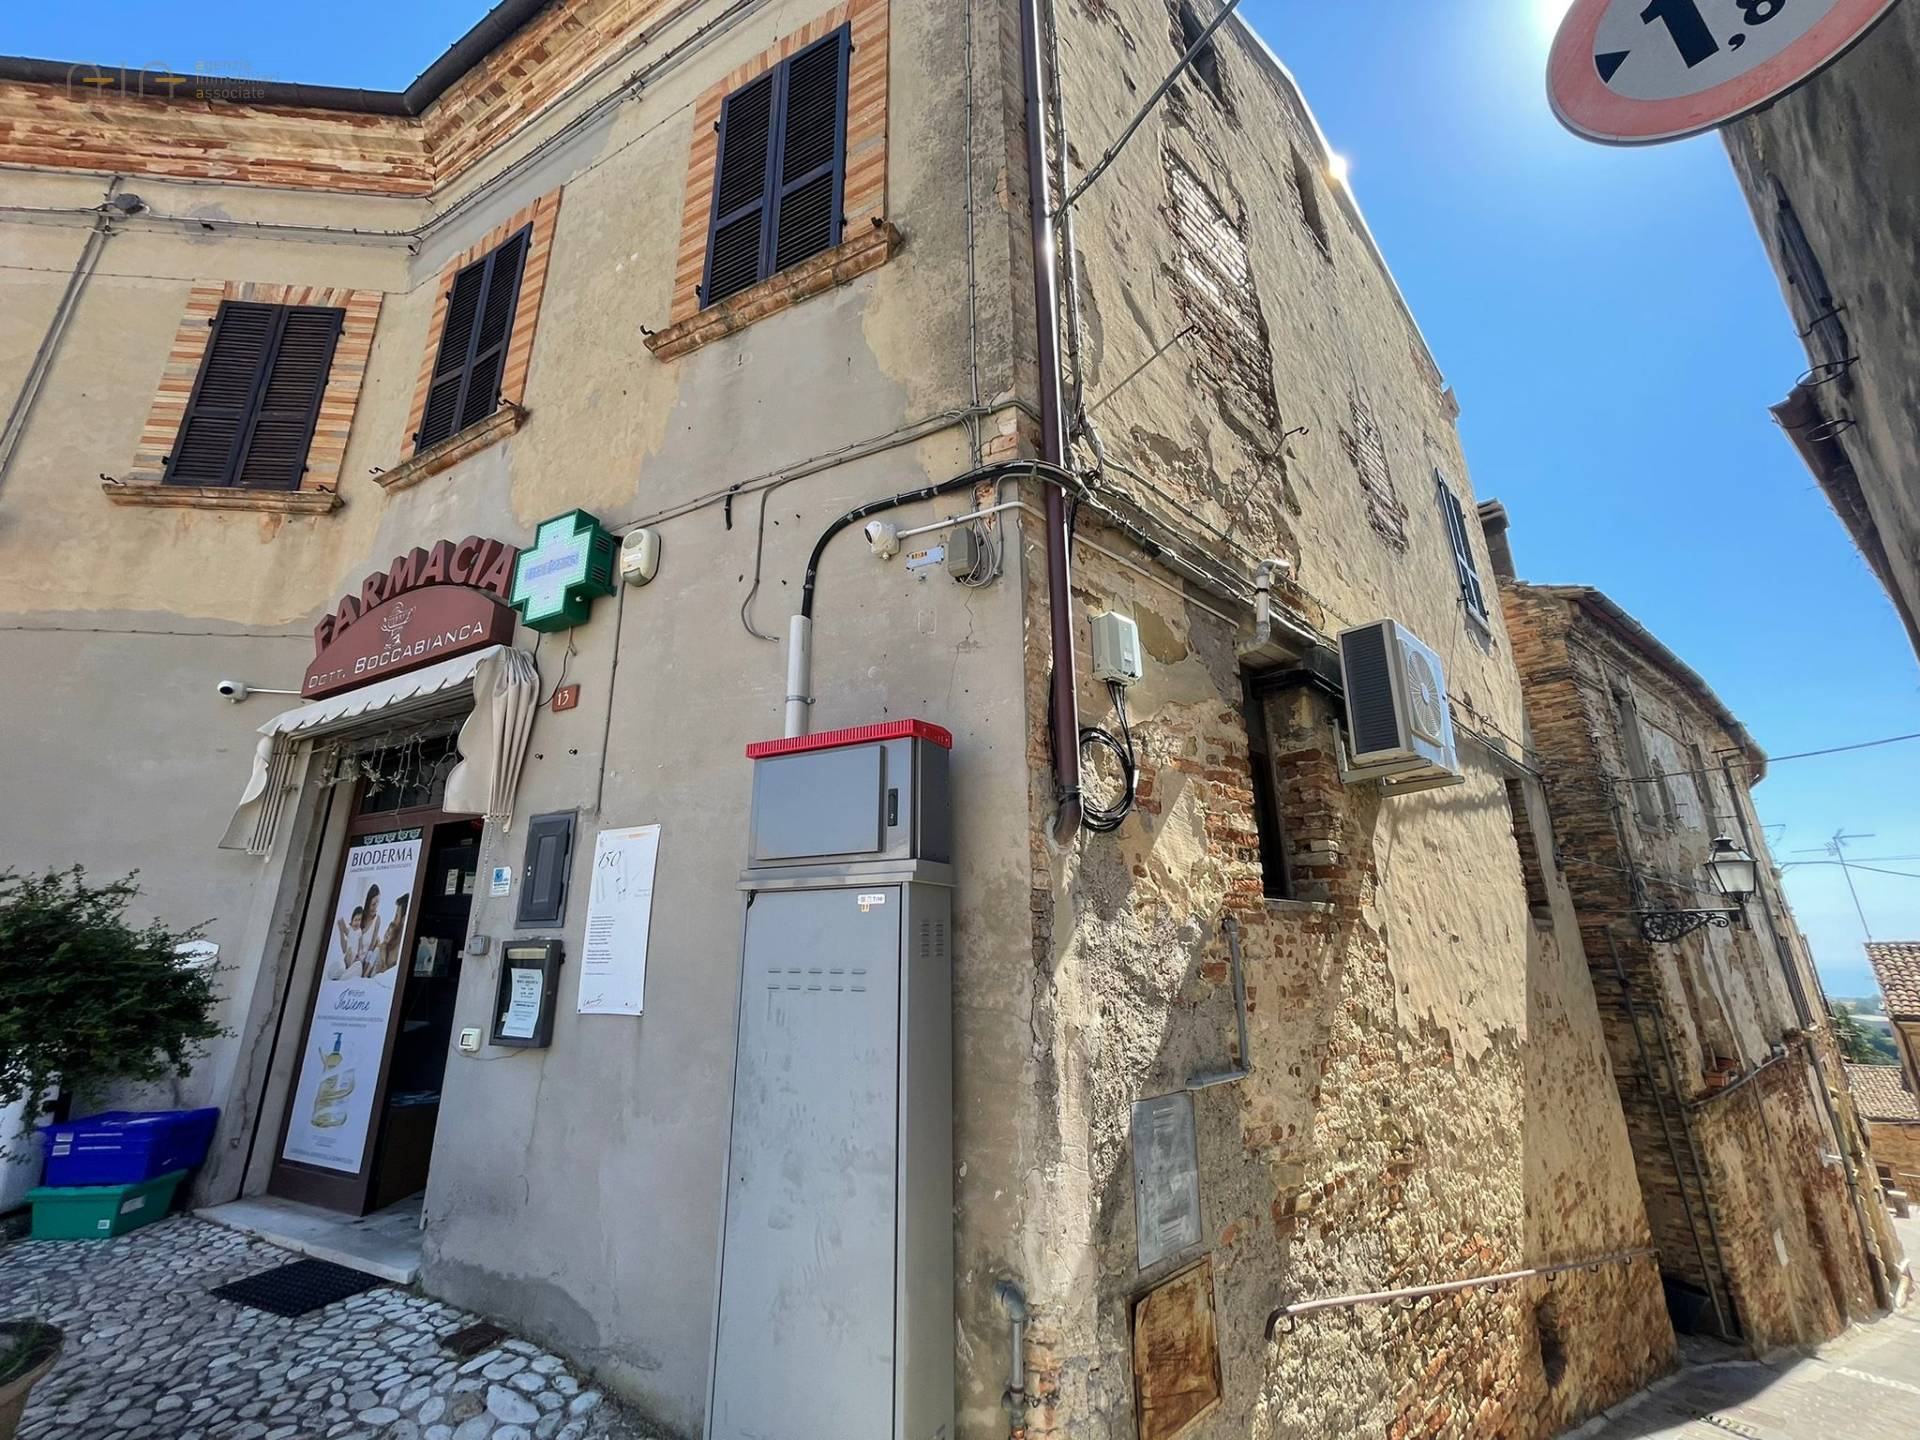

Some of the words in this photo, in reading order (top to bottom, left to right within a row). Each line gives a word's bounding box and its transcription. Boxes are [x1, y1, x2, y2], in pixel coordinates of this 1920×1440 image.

[313, 535, 517, 658] FARMACIA
[354, 620, 484, 674] BOCCABIANCA
[557, 691, 570, 706] 13
[351, 847, 413, 867] BIODERMA
